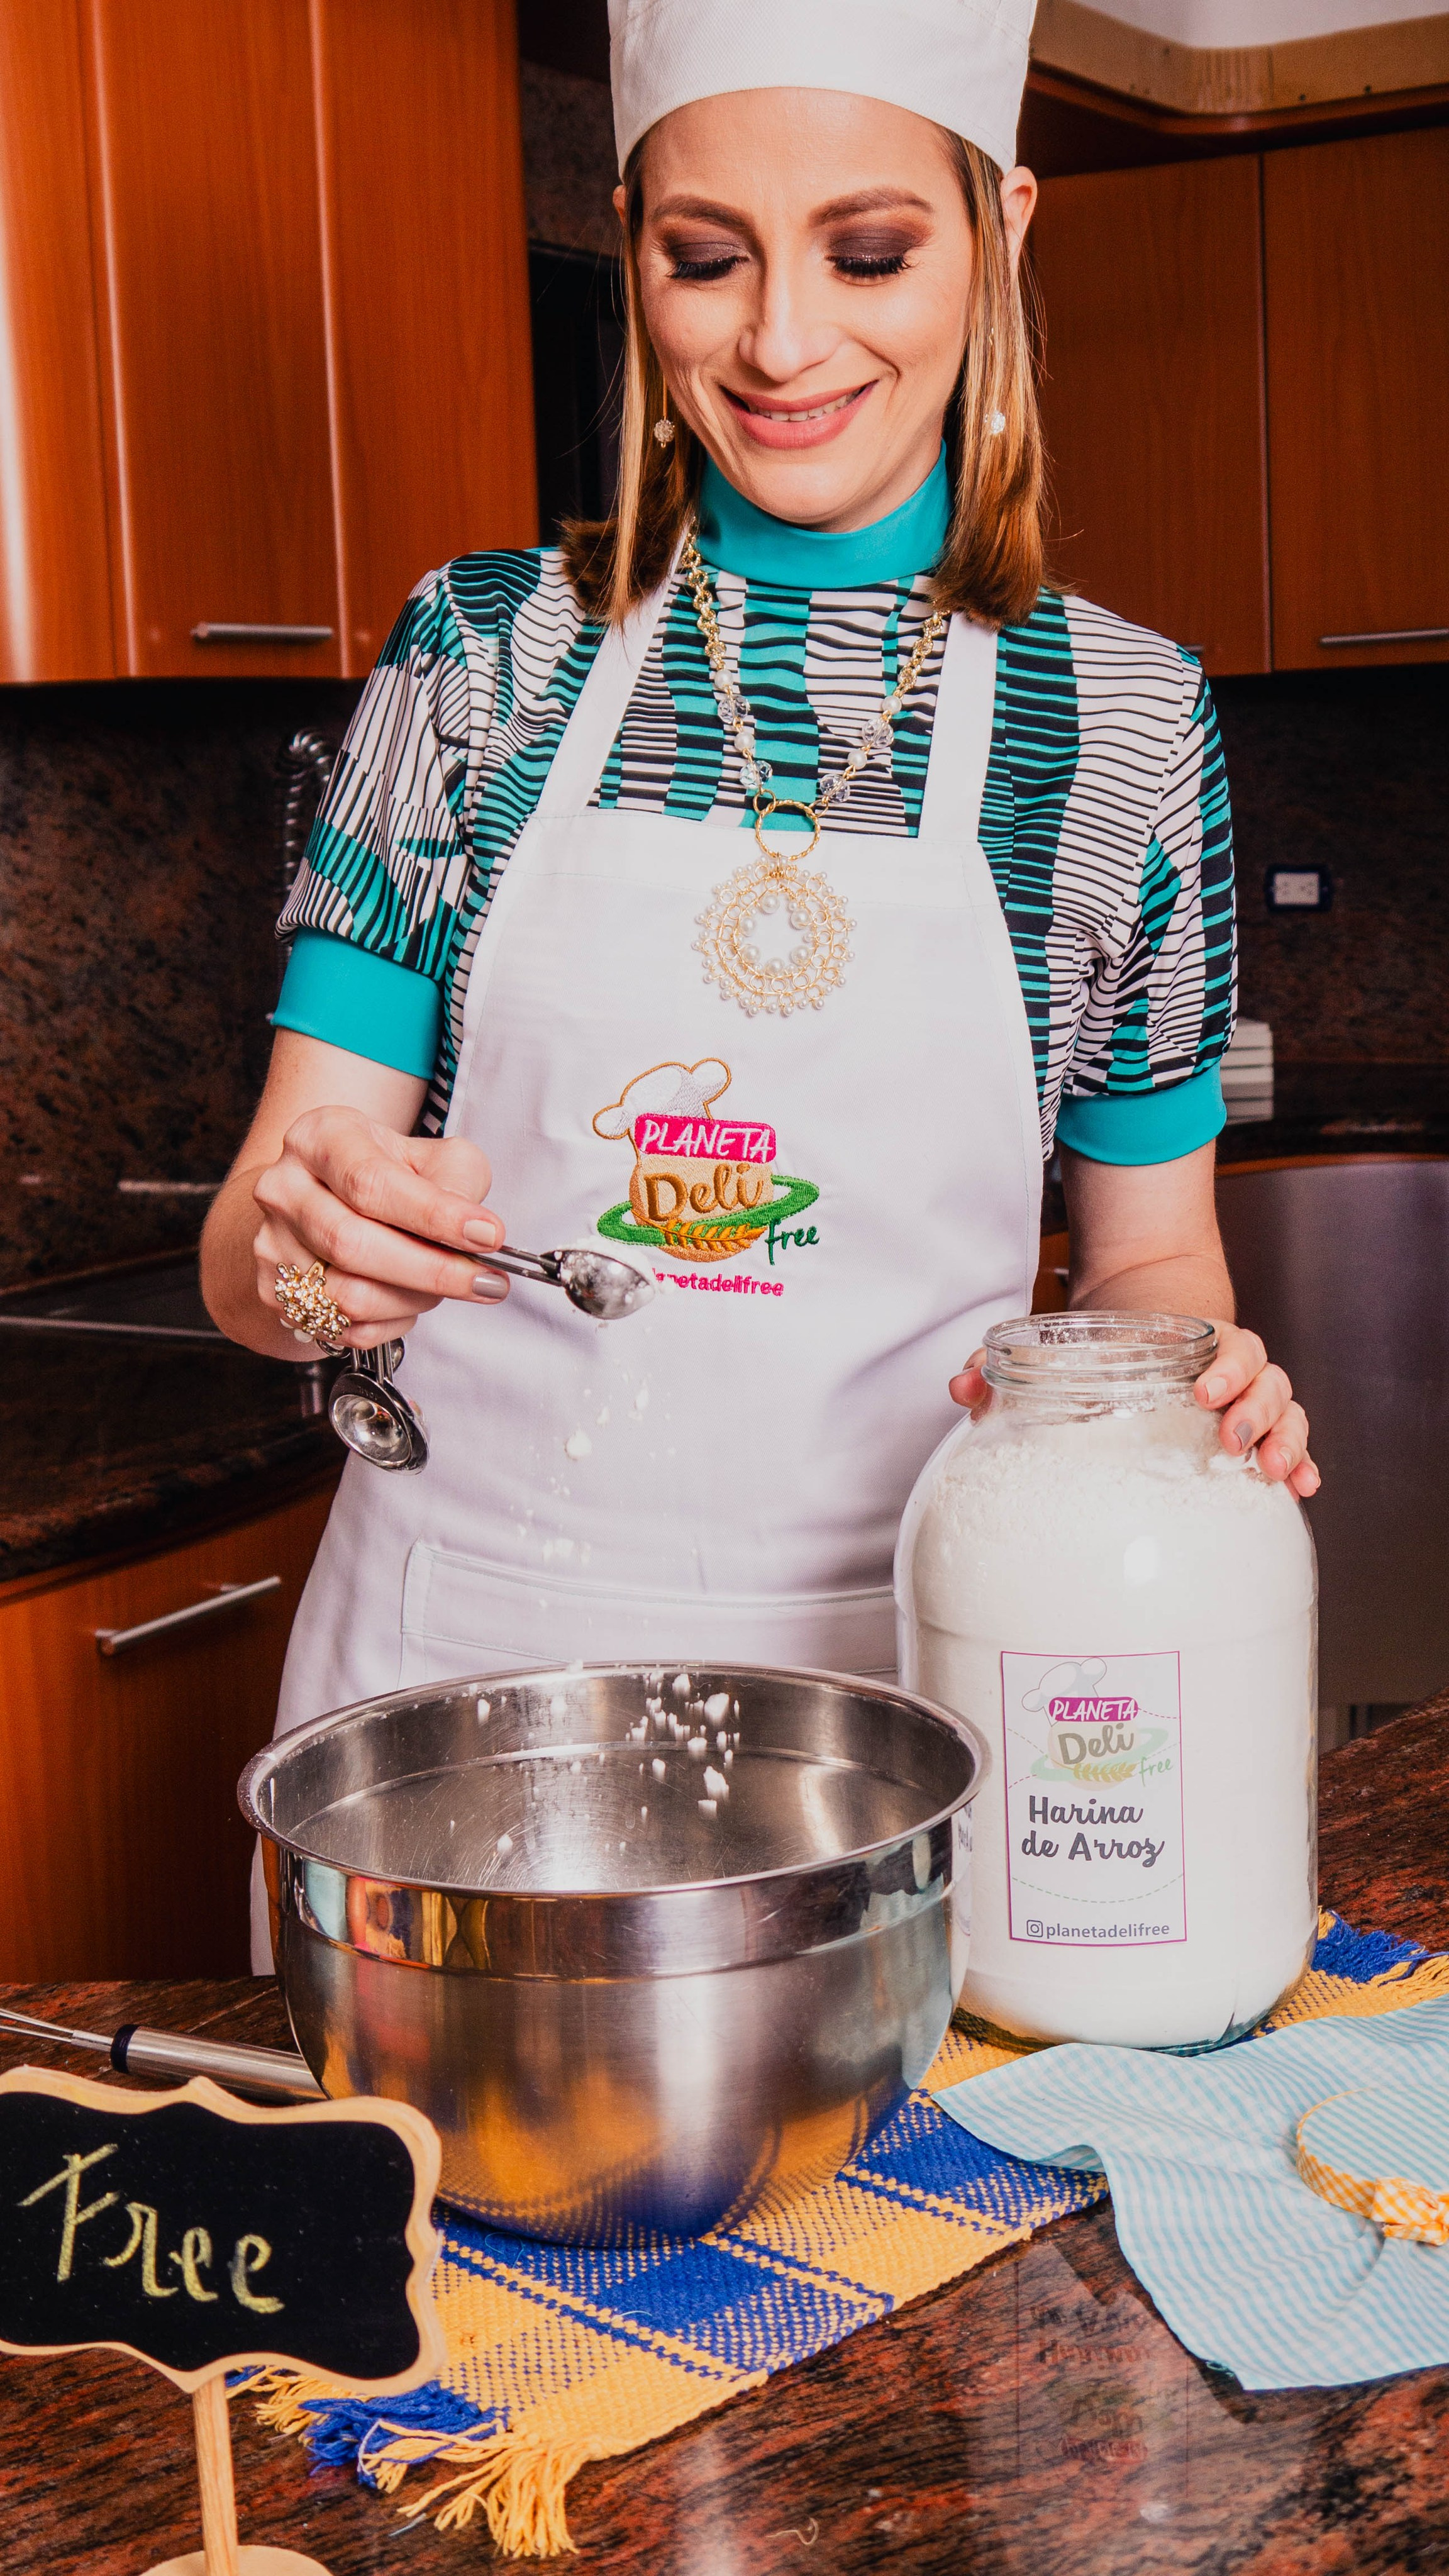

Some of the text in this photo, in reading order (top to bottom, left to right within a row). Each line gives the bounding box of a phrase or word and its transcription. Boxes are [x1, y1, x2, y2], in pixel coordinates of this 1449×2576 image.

[640, 1119, 772, 1162] PLANETA
[644, 1163, 763, 1221] Deli
[764, 1219, 819, 1265] free
[1051, 1699, 1136, 1720] PLANETA
[1058, 1723, 1134, 1765] Deli
[1139, 1757, 1173, 1787] free
[1030, 1796, 1143, 1825] Harina
[1021, 1830, 1165, 1868] de Arroz
[1046, 1923, 1170, 1939] planetadelifree
[17, 2143, 285, 2314] Free
